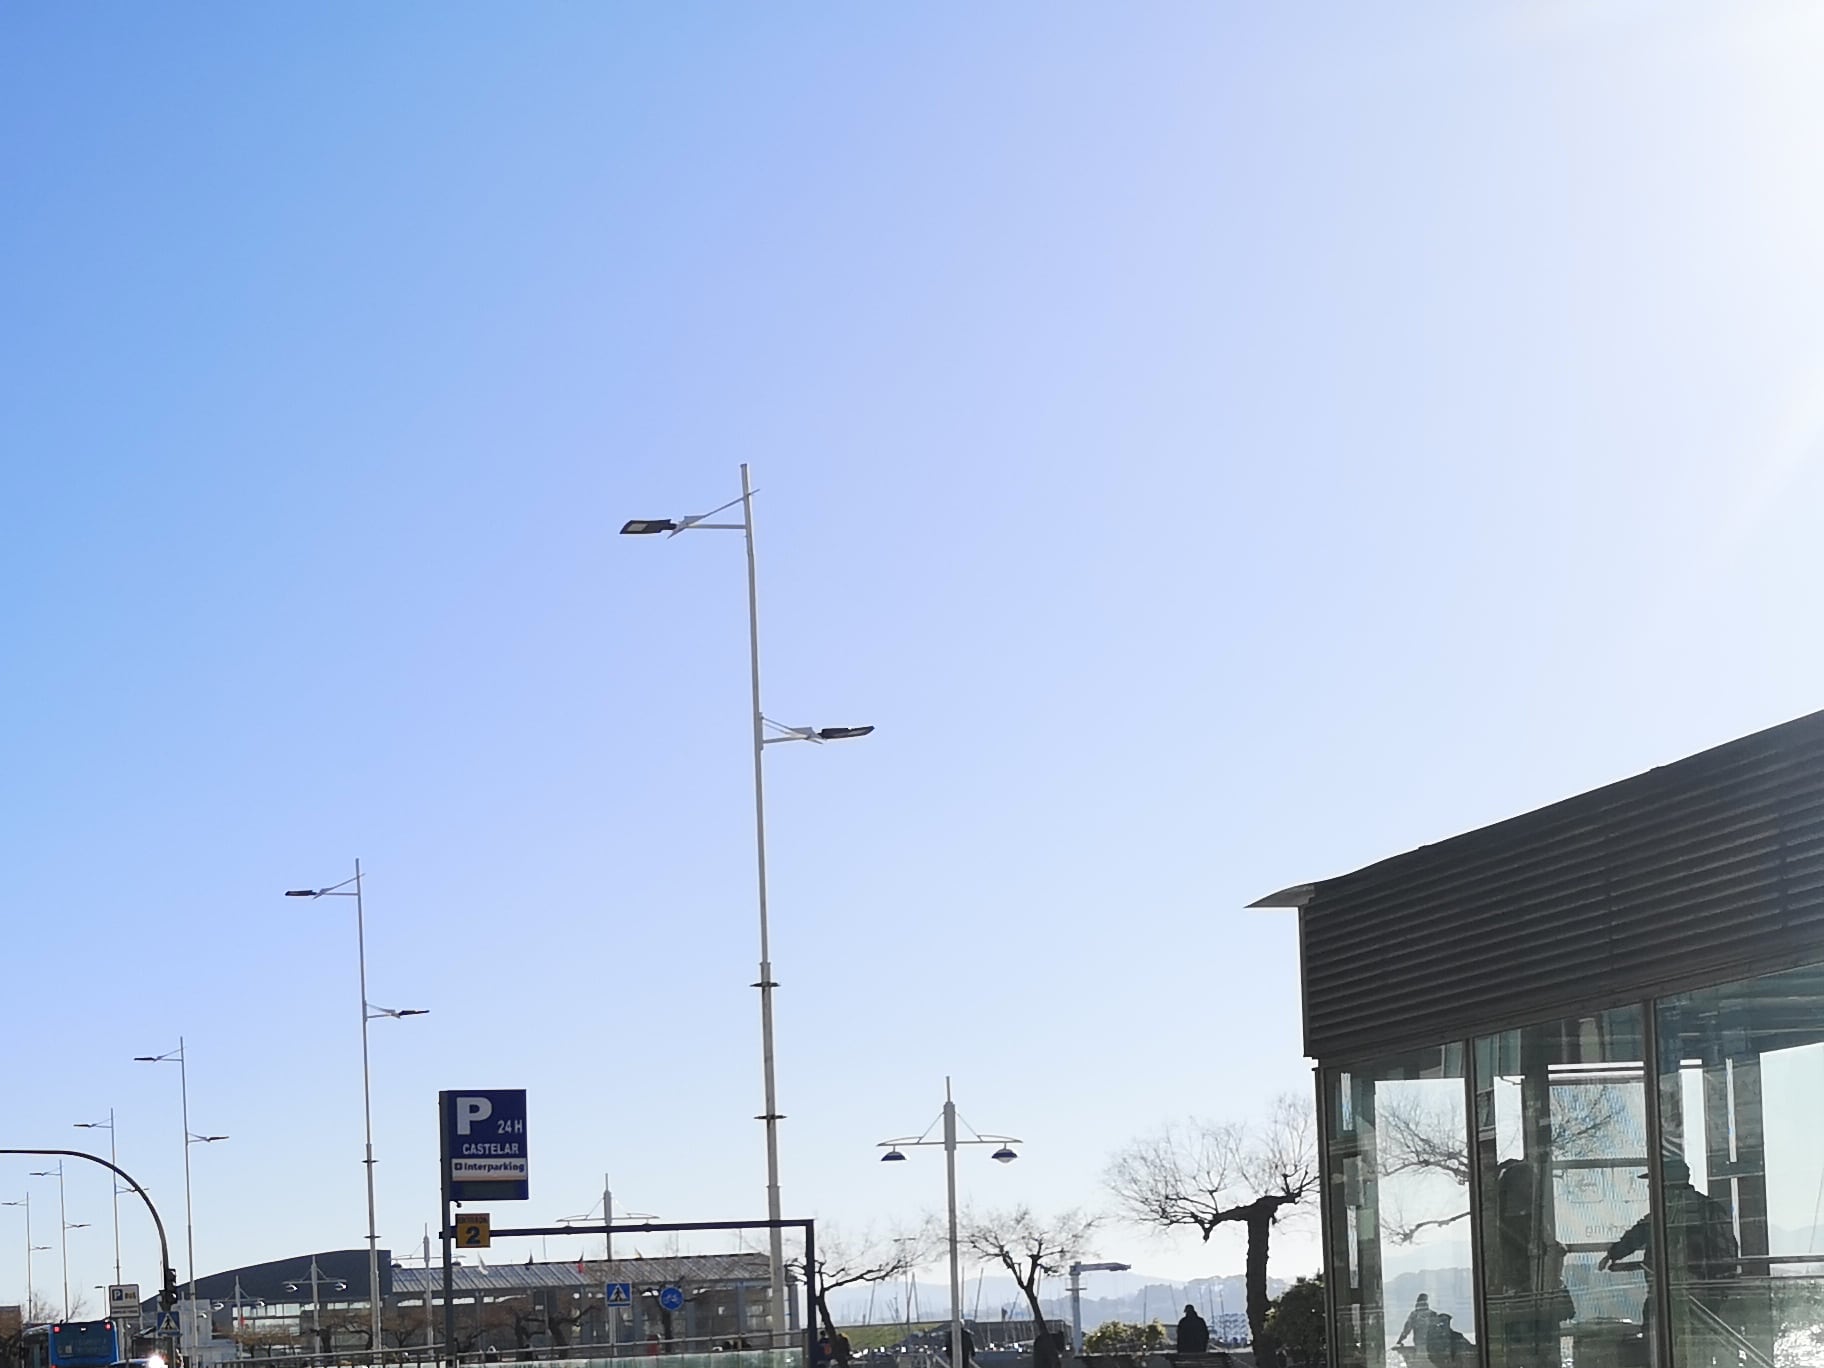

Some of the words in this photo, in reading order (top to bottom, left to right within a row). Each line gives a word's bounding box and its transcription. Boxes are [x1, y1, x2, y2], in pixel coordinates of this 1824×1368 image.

[456, 1096, 493, 1136] P
[497, 1119, 512, 1134] 24
[514, 1119, 523, 1134] H
[462, 1143, 519, 1155] CASTELAR
[464, 1160, 525, 1173] Interparking
[465, 1225, 481, 1245] 2
